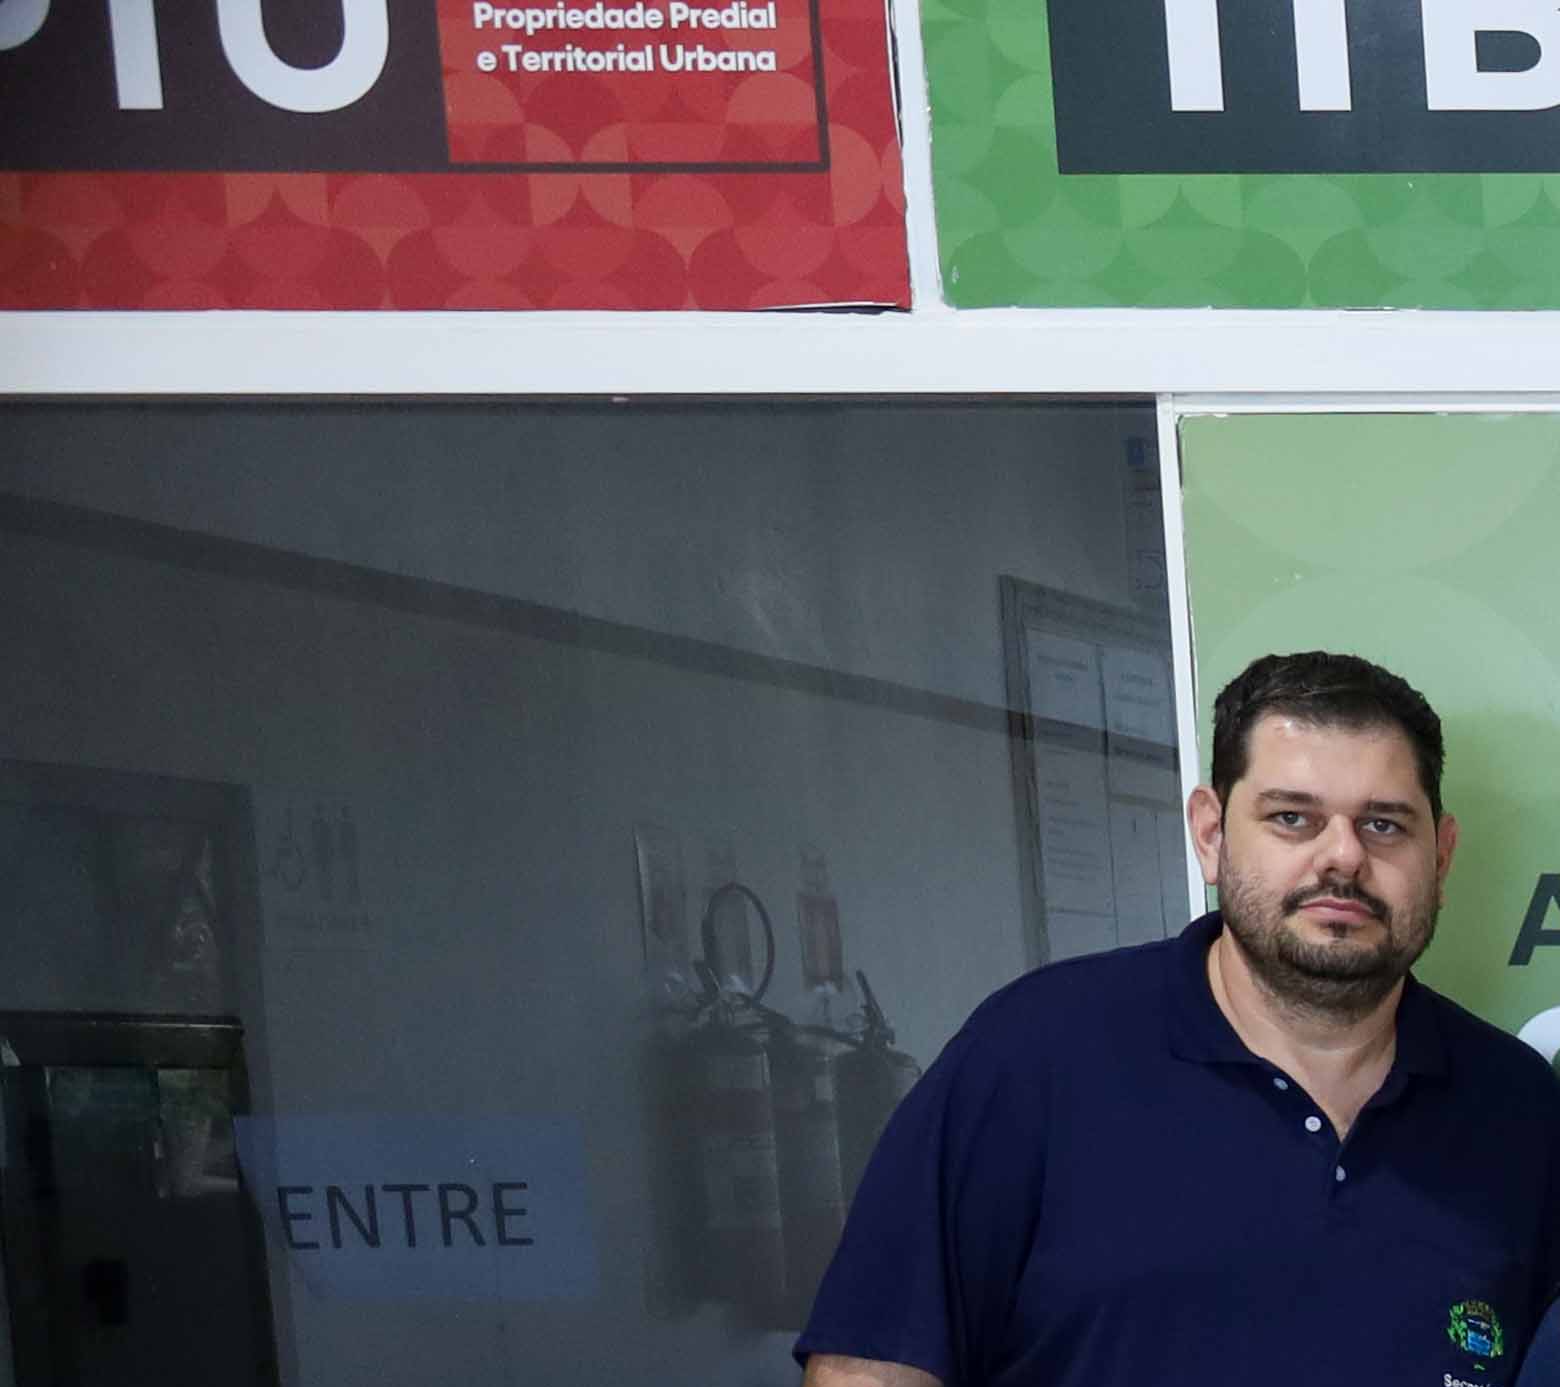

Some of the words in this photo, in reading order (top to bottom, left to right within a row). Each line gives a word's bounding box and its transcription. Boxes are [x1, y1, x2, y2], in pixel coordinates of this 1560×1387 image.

[473, 2, 664, 35] Propriedade
[670, 2, 777, 29] Predial
[477, 50, 497, 71] e
[501, 44, 654, 71] Territorial
[660, 44, 777, 71] Urbana
[277, 1181, 534, 1249] ENTRE
